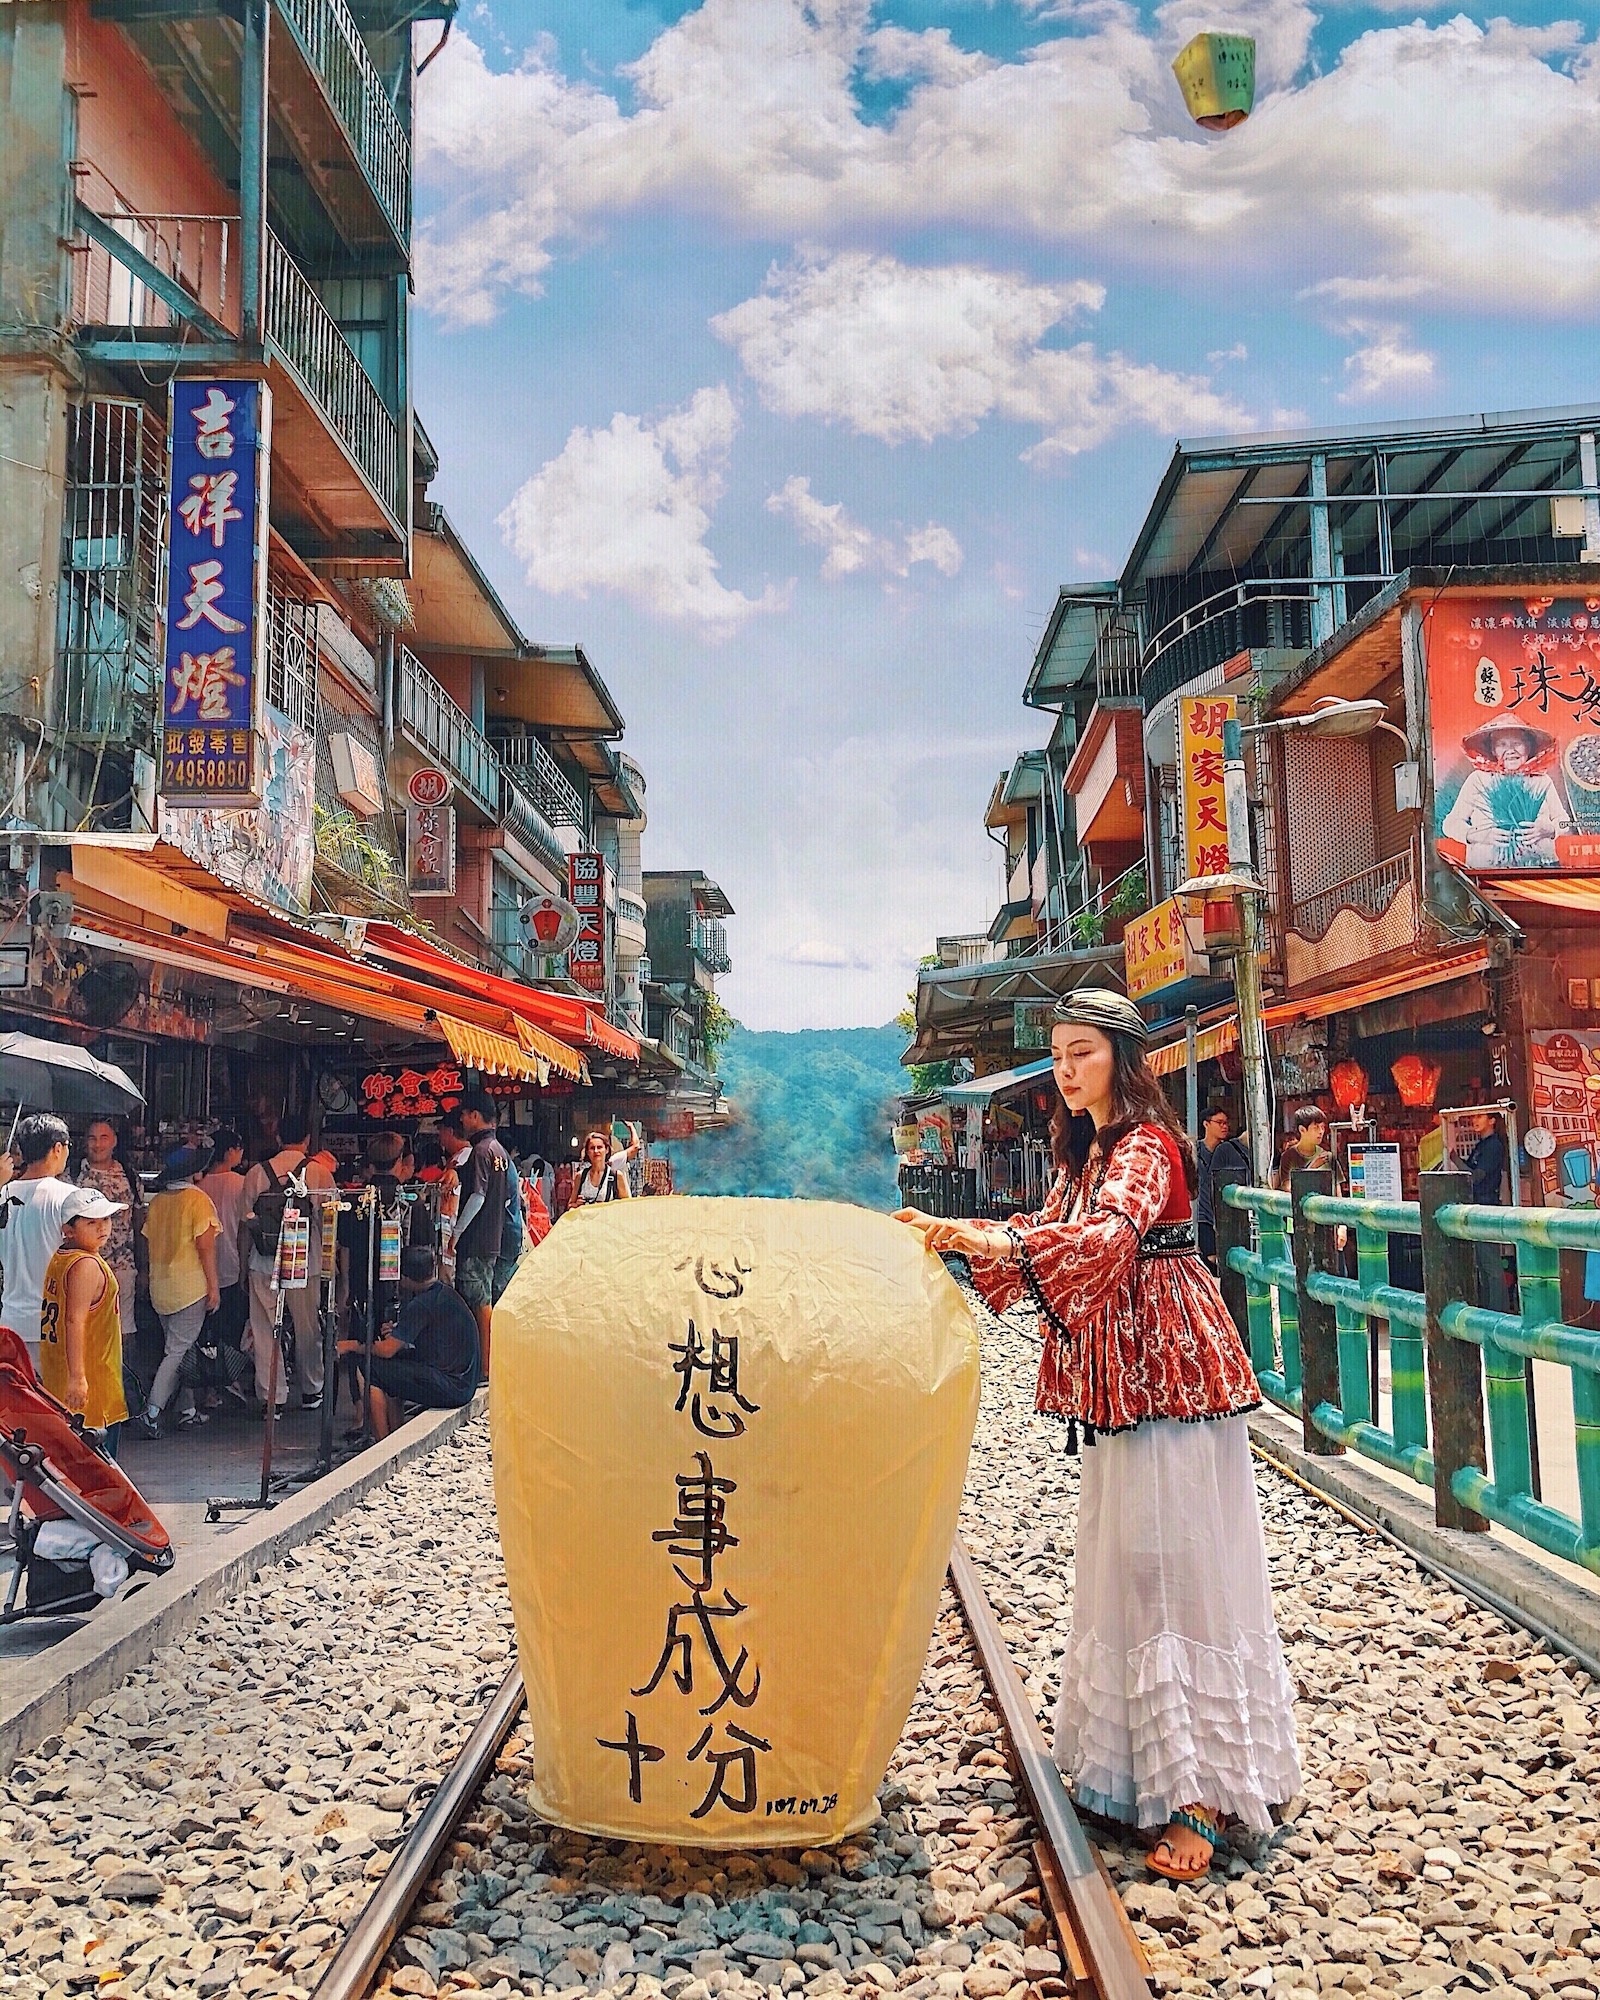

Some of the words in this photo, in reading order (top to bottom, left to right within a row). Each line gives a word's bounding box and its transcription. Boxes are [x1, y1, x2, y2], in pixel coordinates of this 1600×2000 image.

[171, 387, 246, 720] 吉祥天燈
[165, 728, 247, 754] 批發零售
[165, 759, 246, 787] 24958850
[1188, 701, 1229, 877] 胡家天燈
[1559, 821, 1581, 829] green
[1126, 903, 1182, 966] 胡家天燈
[361, 1069, 465, 1099] 你會紅
[41, 1298, 60, 1343] 23
[595, 1709, 773, 1818] 十分
